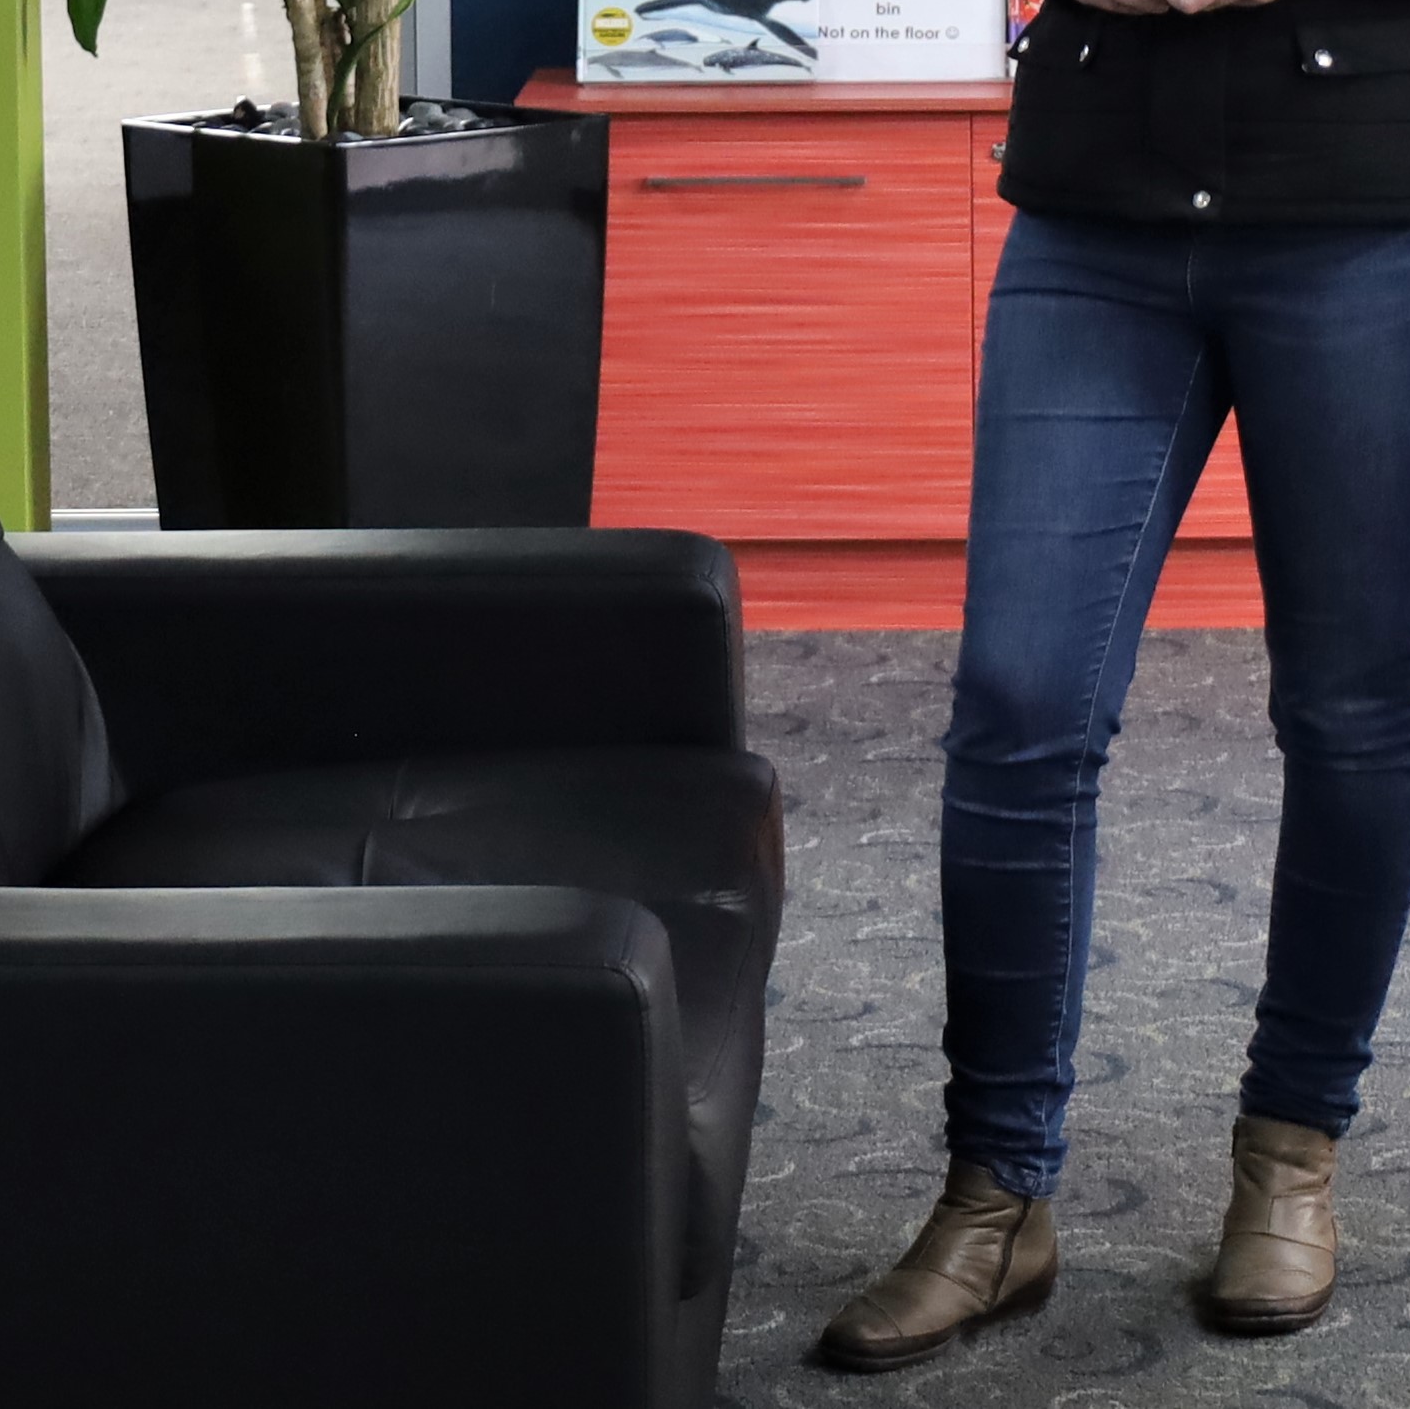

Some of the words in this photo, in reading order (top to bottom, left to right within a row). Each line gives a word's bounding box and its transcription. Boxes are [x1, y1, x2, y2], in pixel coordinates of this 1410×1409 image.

[876, 2, 901, 15] bin
[818, 26, 845, 39] Not
[850, 28, 870, 39] on
[875, 26, 900, 39] the
[905, 26, 940, 39] floor
